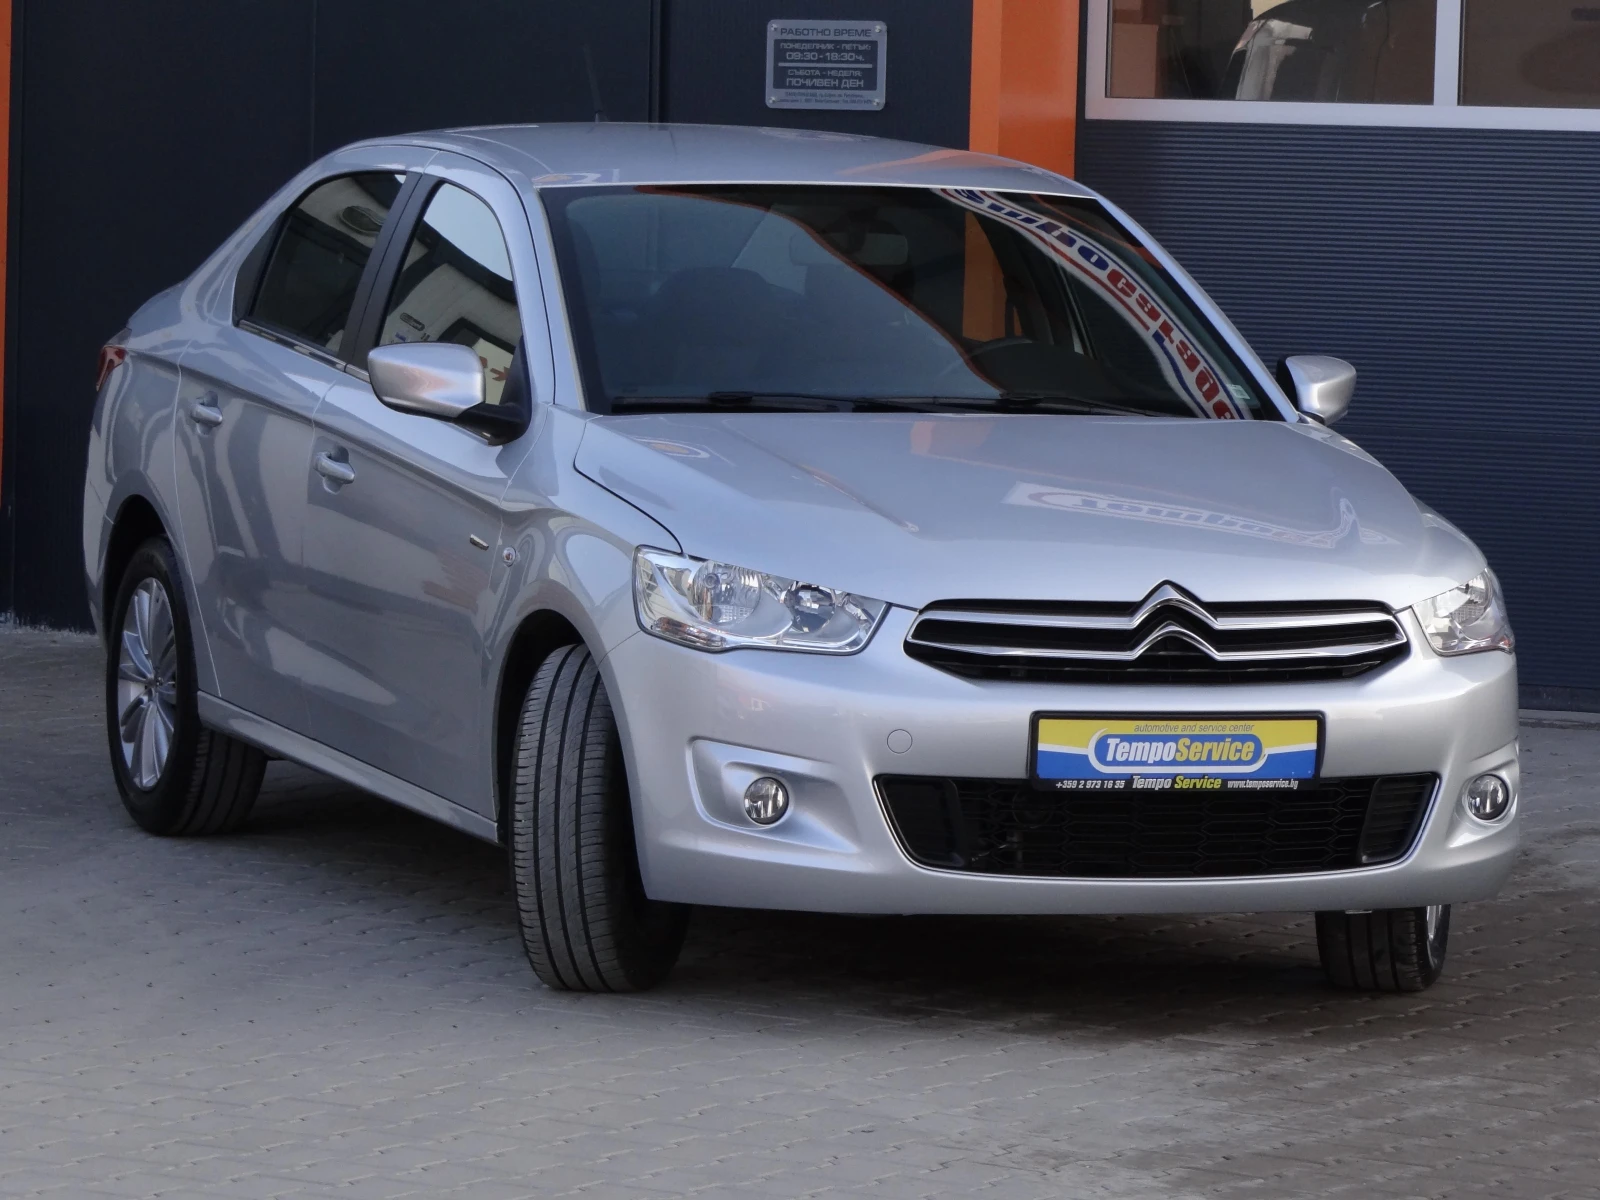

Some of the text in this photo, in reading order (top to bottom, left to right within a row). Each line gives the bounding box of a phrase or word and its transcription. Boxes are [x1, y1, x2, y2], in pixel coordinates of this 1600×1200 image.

[780, 27, 872, 38] РАБОТНО ВРЕМЕ
[780, 42, 834, 50] ПОНЕДЕЛНИК
[787, 69, 821, 77] СЪБОТА
[786, 78, 864, 88] ПОЧИВЕН ДЕН
[1134, 723, 1255, 732] automotive and service center
[1106, 737, 1255, 764] TempoService
[1055, 775, 1299, 791] +359 2 973 16 35 Tempo Service www.temposervice.bg
